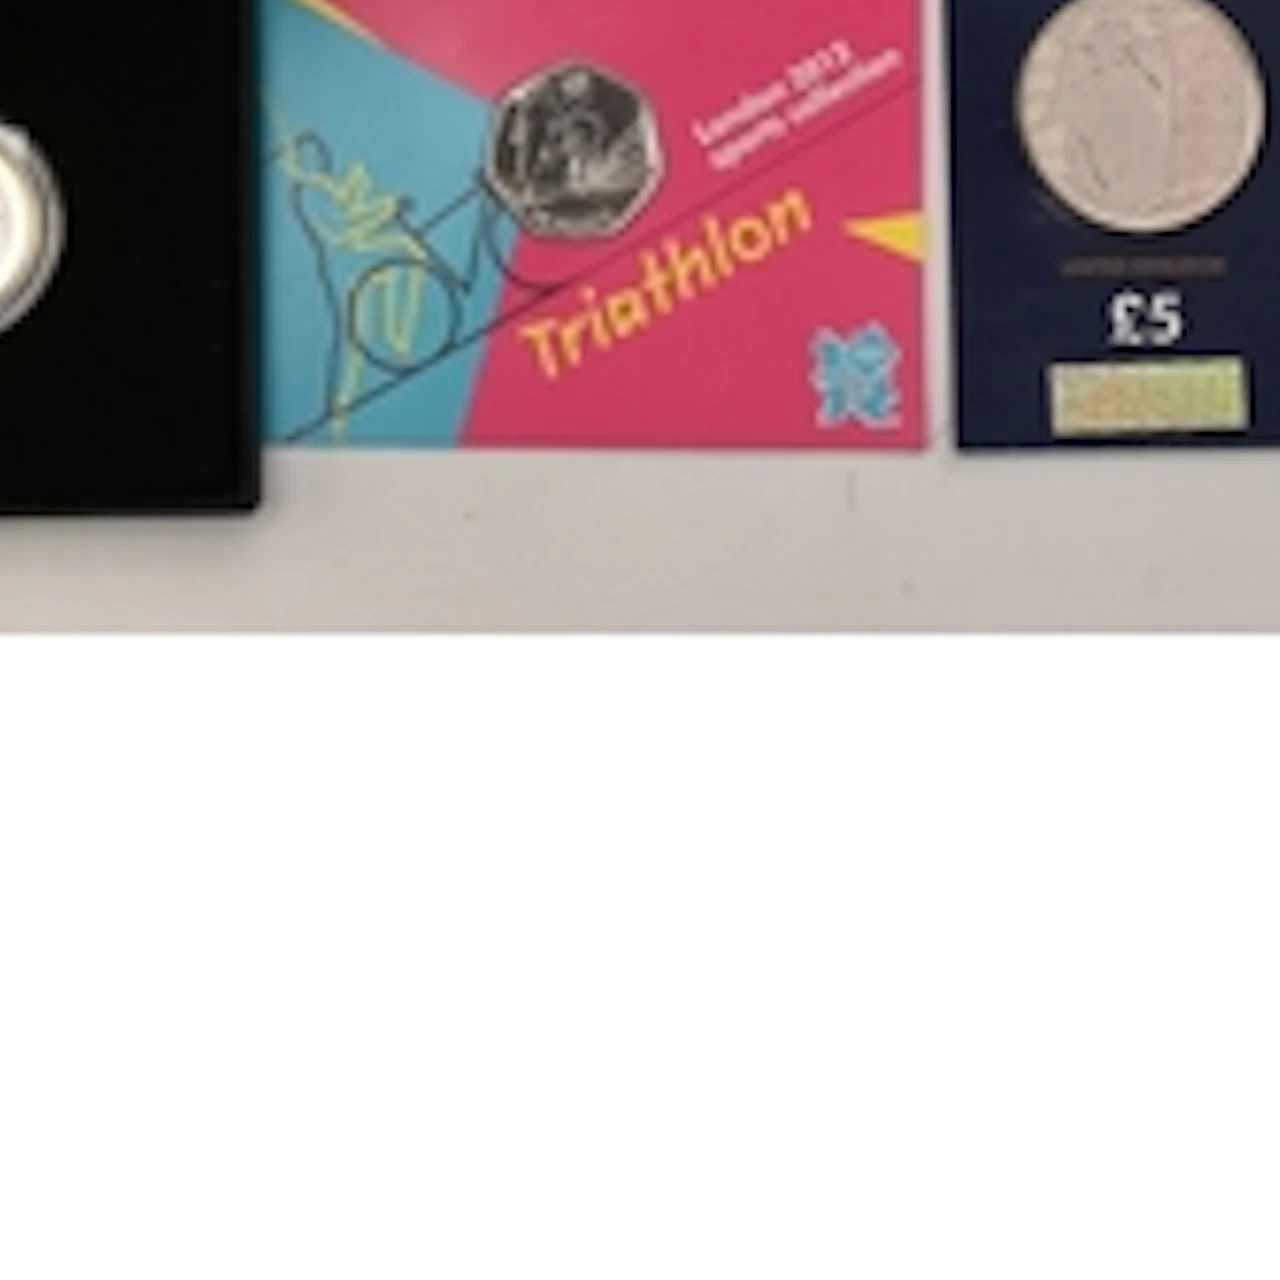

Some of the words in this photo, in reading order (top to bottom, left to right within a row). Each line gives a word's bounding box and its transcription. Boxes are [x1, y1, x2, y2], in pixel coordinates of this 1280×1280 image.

[689, 80, 789, 148] London
[520, 187, 813, 382] Triathlon
[1109, 290, 1183, 346] £5
